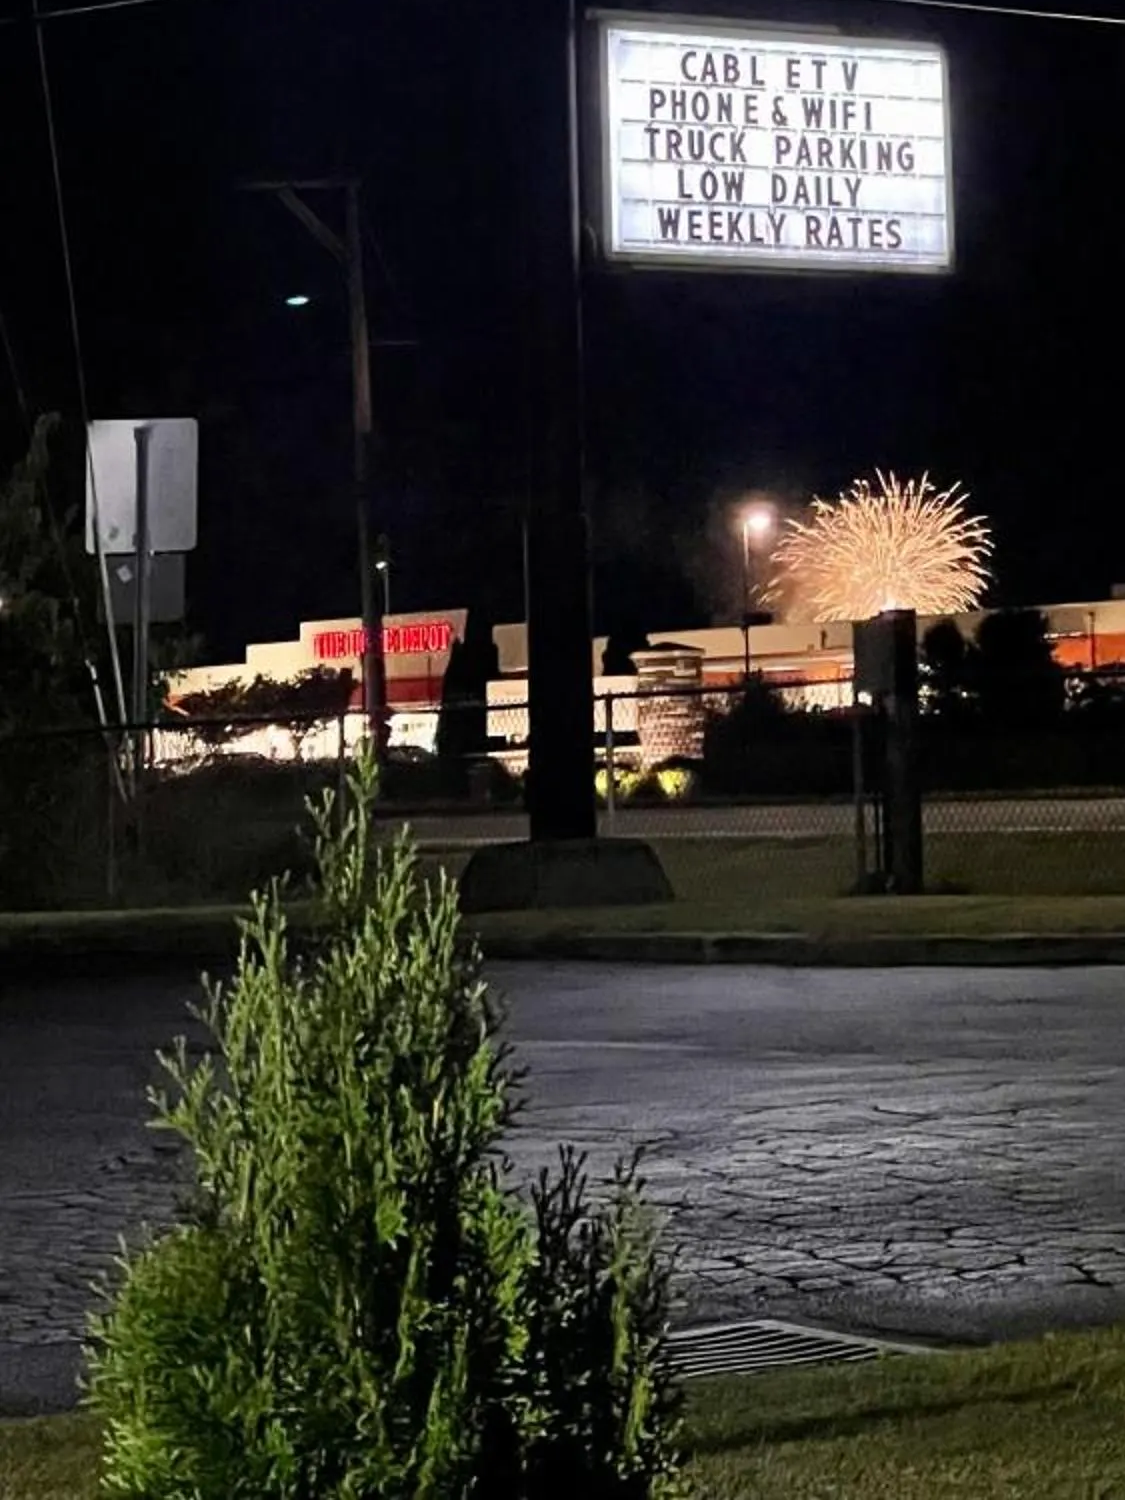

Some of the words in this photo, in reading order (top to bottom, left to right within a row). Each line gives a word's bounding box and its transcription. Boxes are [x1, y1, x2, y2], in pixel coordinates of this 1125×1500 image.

[649, 88, 759, 125] PHONE
[771, 95, 788, 126] &
[802, 97, 872, 131] WIFI
[644, 127, 747, 163] TRUCK
[774, 135, 915, 172] PARKING
[677, 168, 745, 202] LOW
[771, 174, 862, 207] DAILY
[657, 207, 786, 244] WEEKLY
[804, 215, 902, 249] RATES
[399, 624, 451, 653] DEPOT
